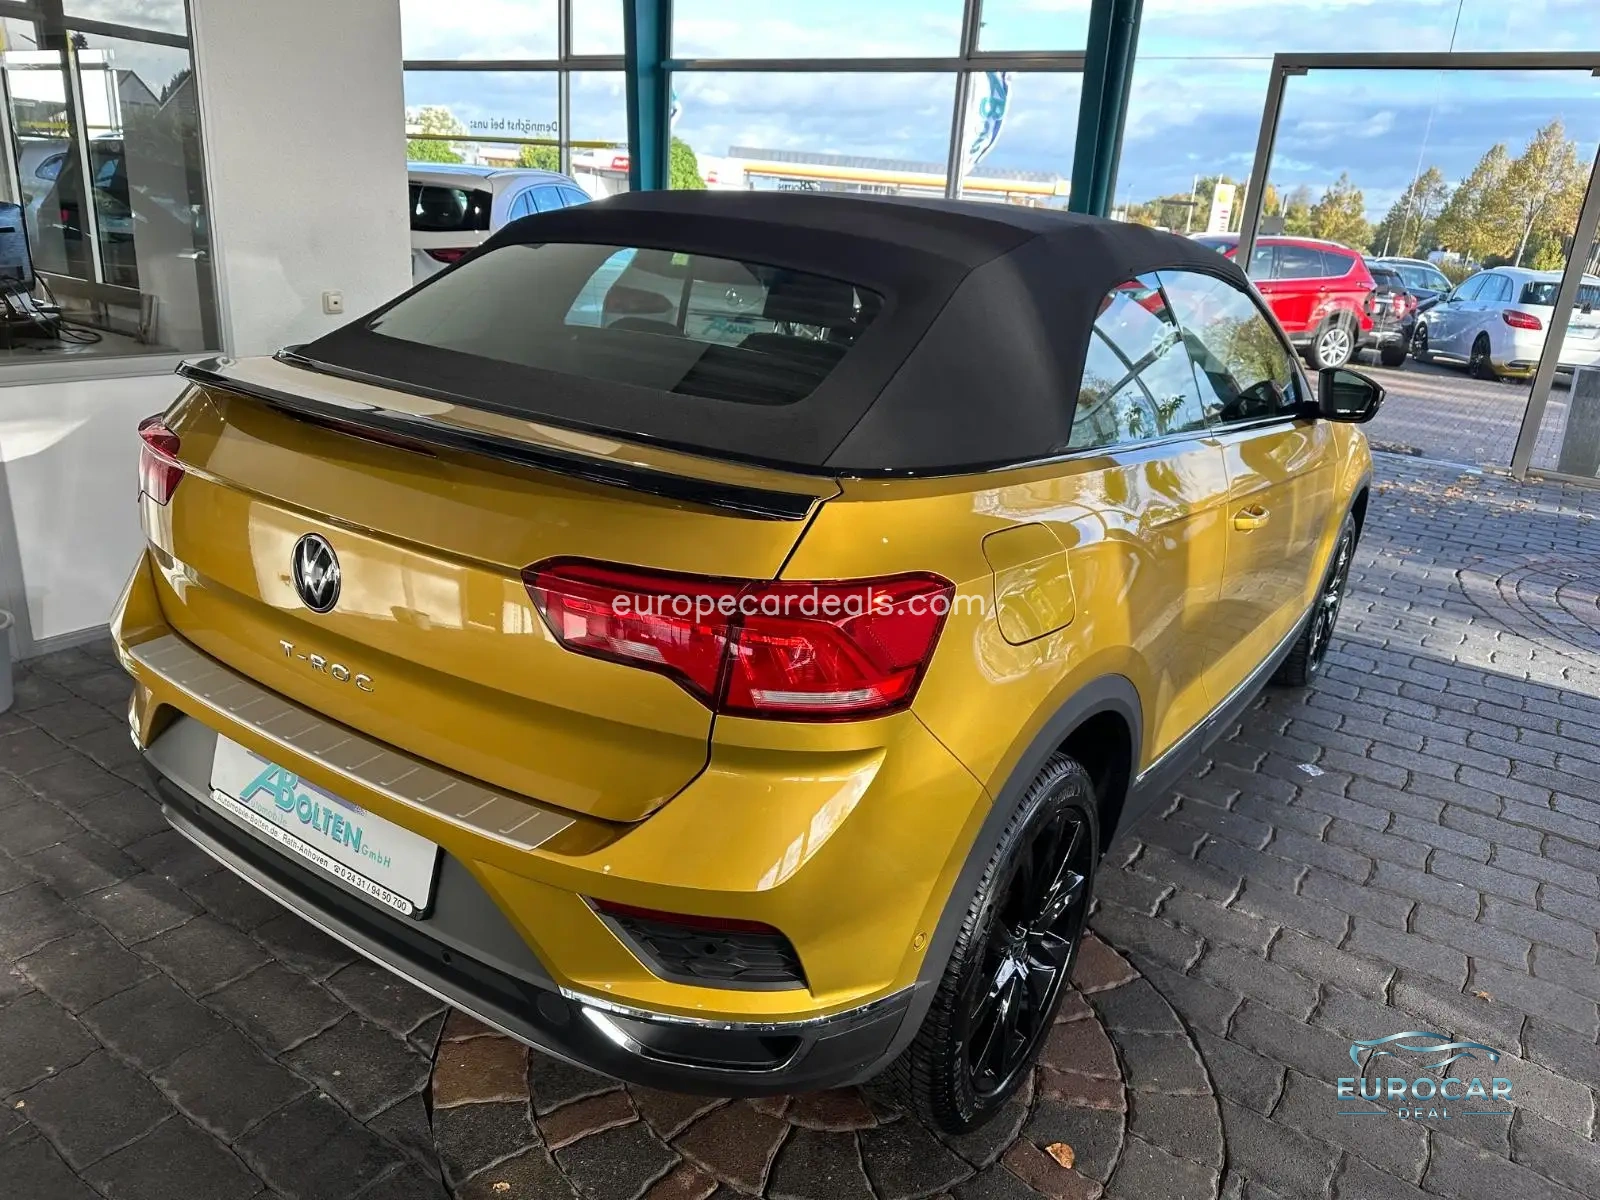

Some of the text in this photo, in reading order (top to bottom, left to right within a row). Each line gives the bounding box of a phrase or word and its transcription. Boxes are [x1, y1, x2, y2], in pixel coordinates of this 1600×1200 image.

[279, 639, 374, 693] T-ROC
[282, 834, 329, 867] Rath-Anhoven
[347, 872, 356, 883] 24
[357, 877, 365, 888] 31
[371, 883, 380, 896] 94
[382, 890, 391, 903] 50
[392, 896, 407, 911] 700
[361, 845, 392, 868] GmbH
